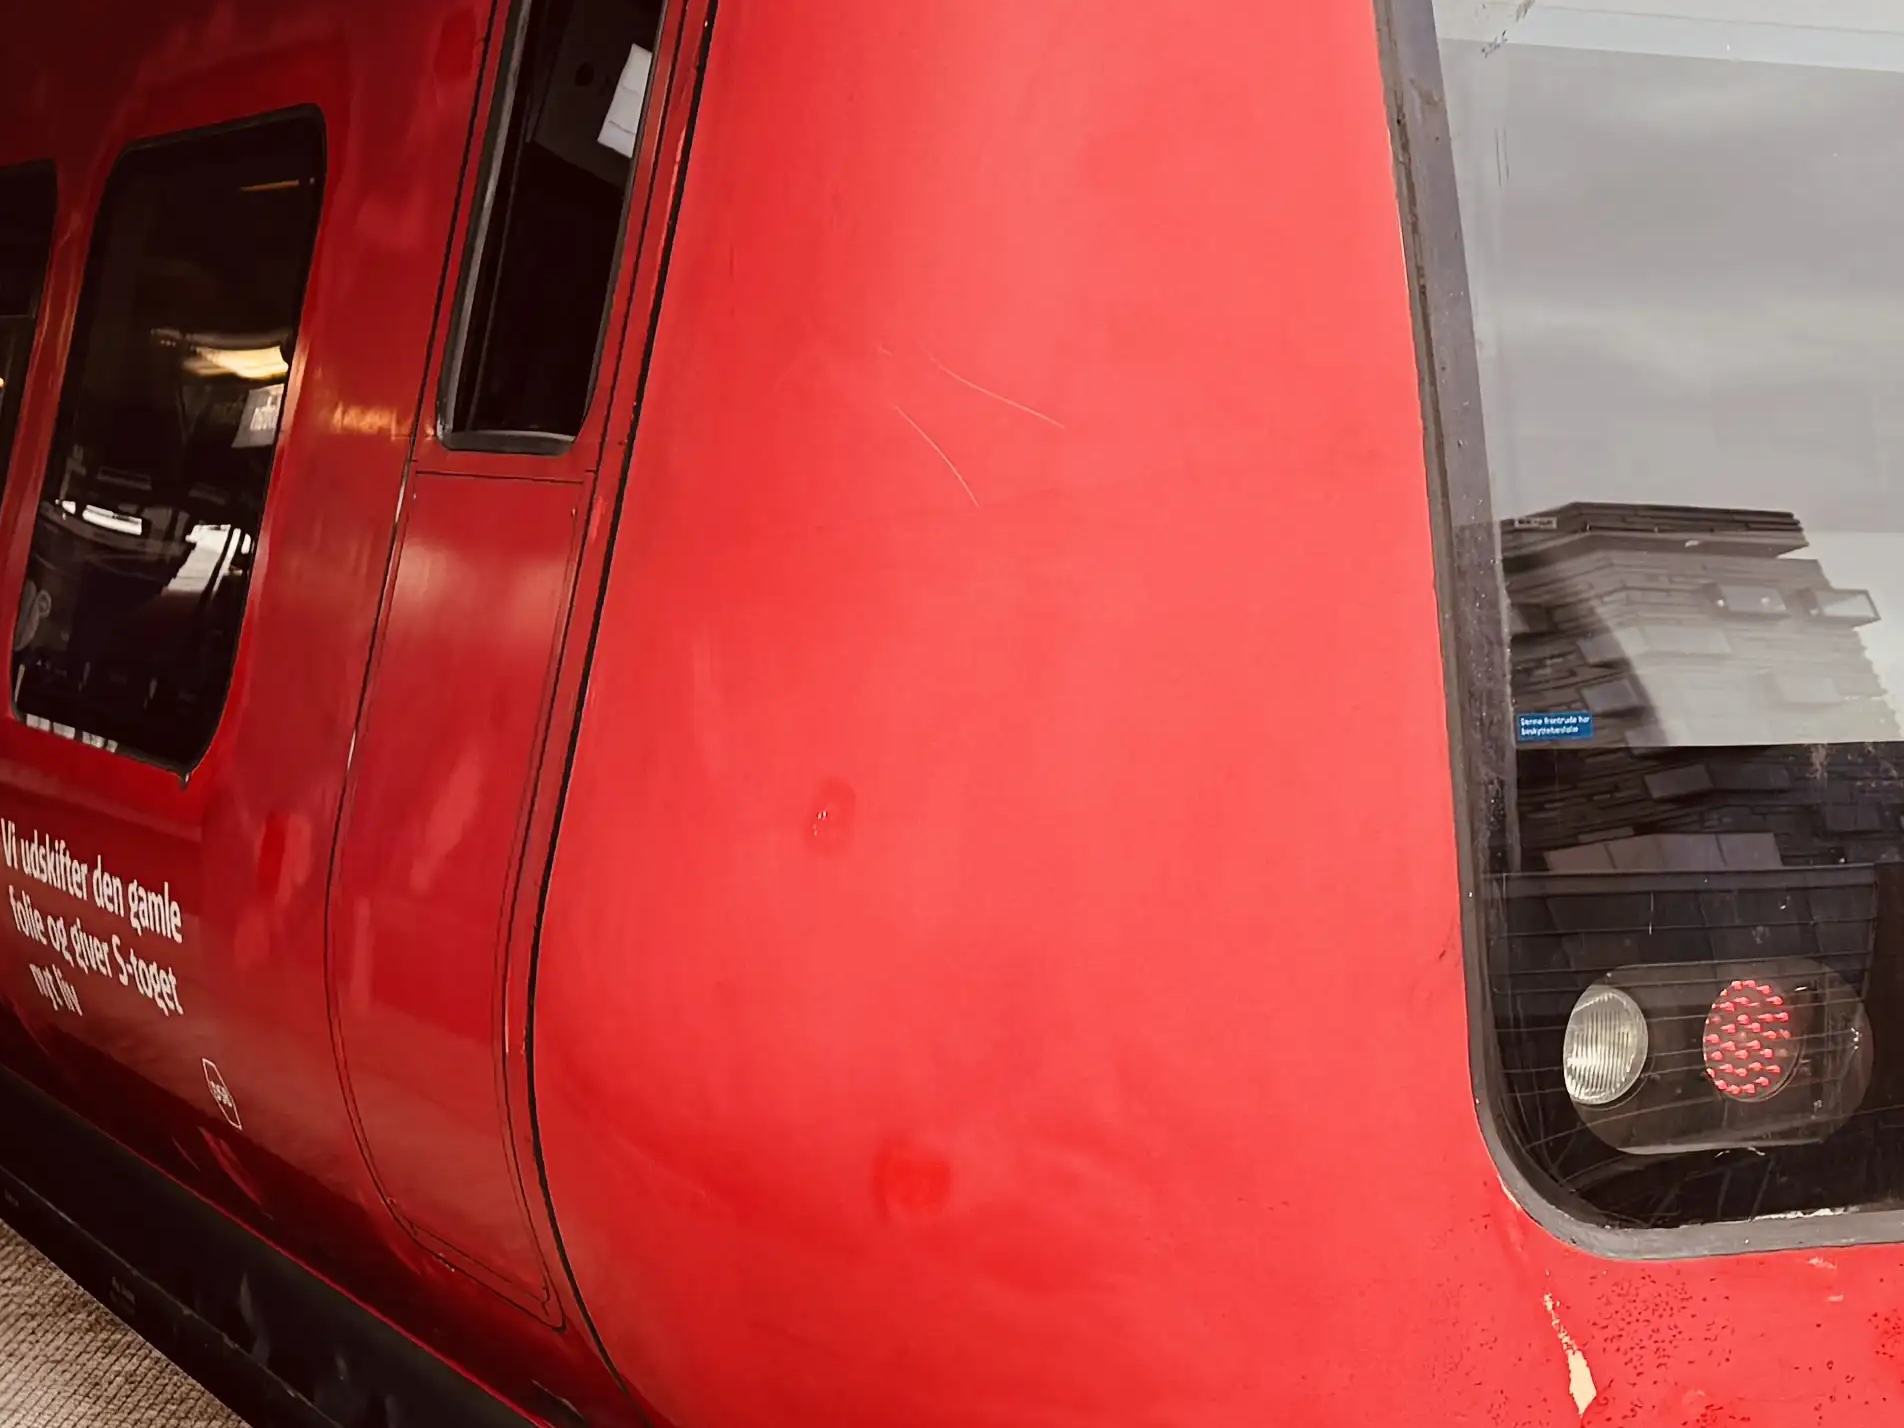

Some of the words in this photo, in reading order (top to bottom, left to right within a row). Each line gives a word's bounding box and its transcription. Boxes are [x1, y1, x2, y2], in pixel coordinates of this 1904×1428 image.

[0, 817, 18, 871] Vi
[20, 829, 88, 901] udskifter
[92, 854, 124, 918] den
[128, 879, 183, 944] gamle
[8, 884, 47, 946] folie
[46, 915, 74, 968] og
[70, 917, 113, 978] giver
[112, 934, 184, 1017] S-toget
